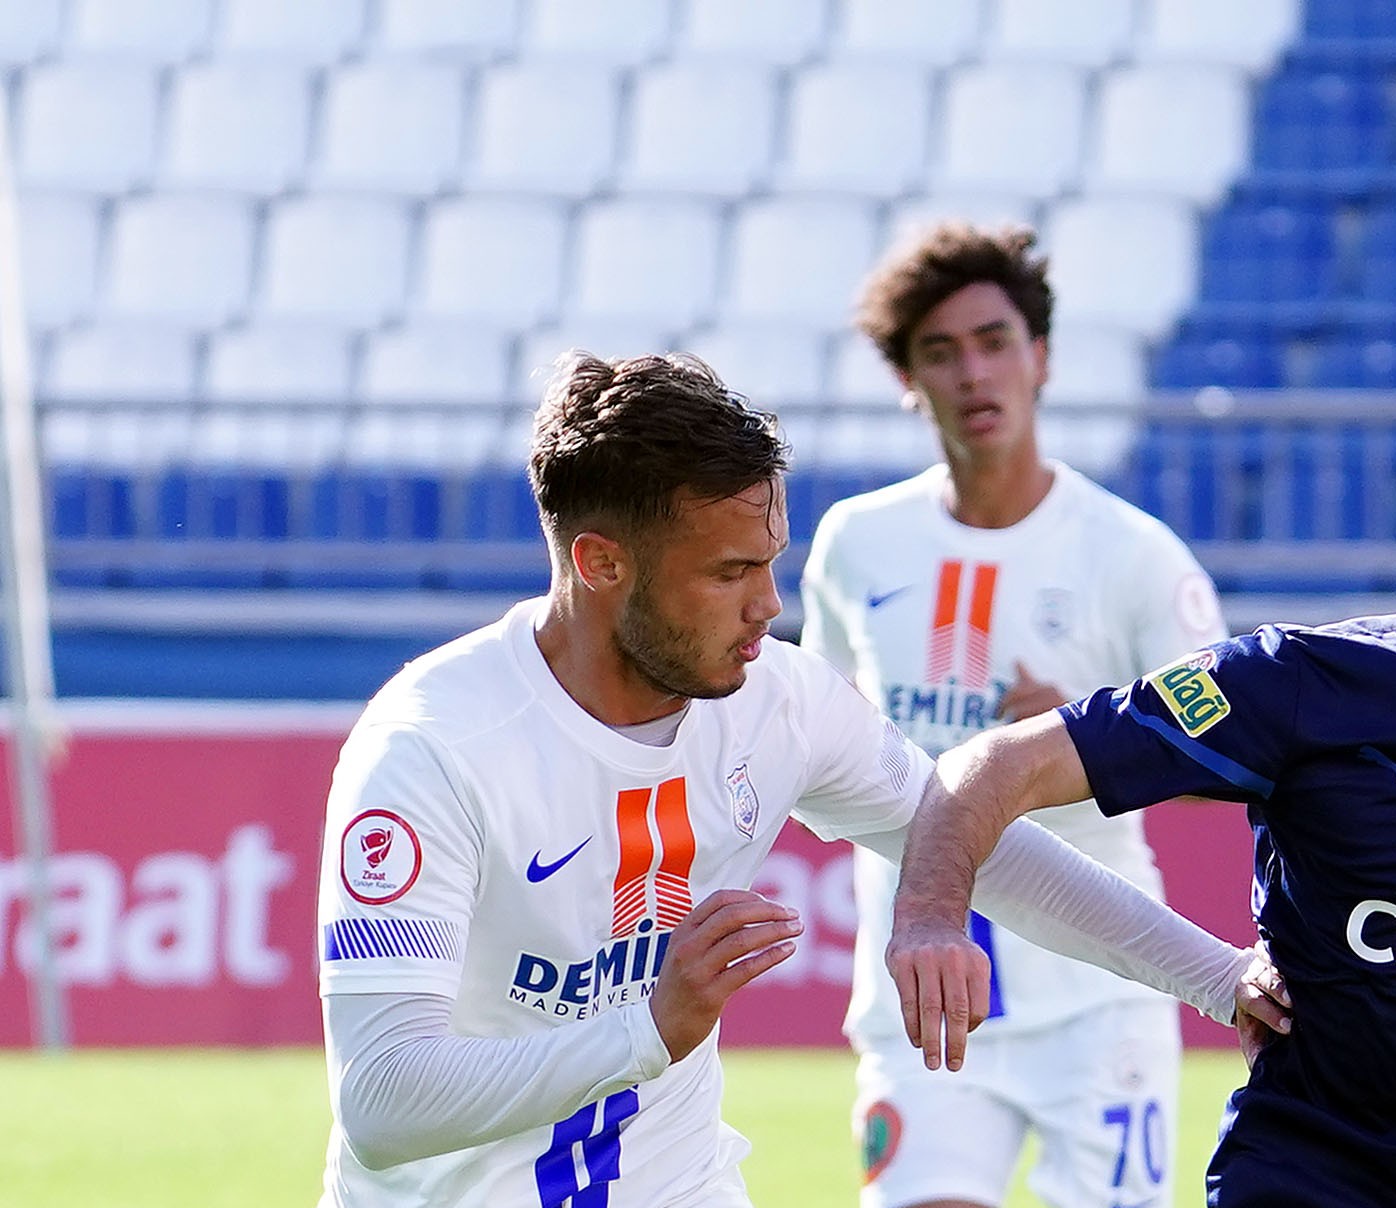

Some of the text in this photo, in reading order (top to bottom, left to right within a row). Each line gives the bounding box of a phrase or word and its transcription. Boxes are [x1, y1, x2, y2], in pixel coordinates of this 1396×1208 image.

[361, 869, 386, 881] Ziraat
[509, 988, 600, 1020] MADEN
[607, 988, 628, 1005] VE
[1102, 1099, 1168, 1188] 70
